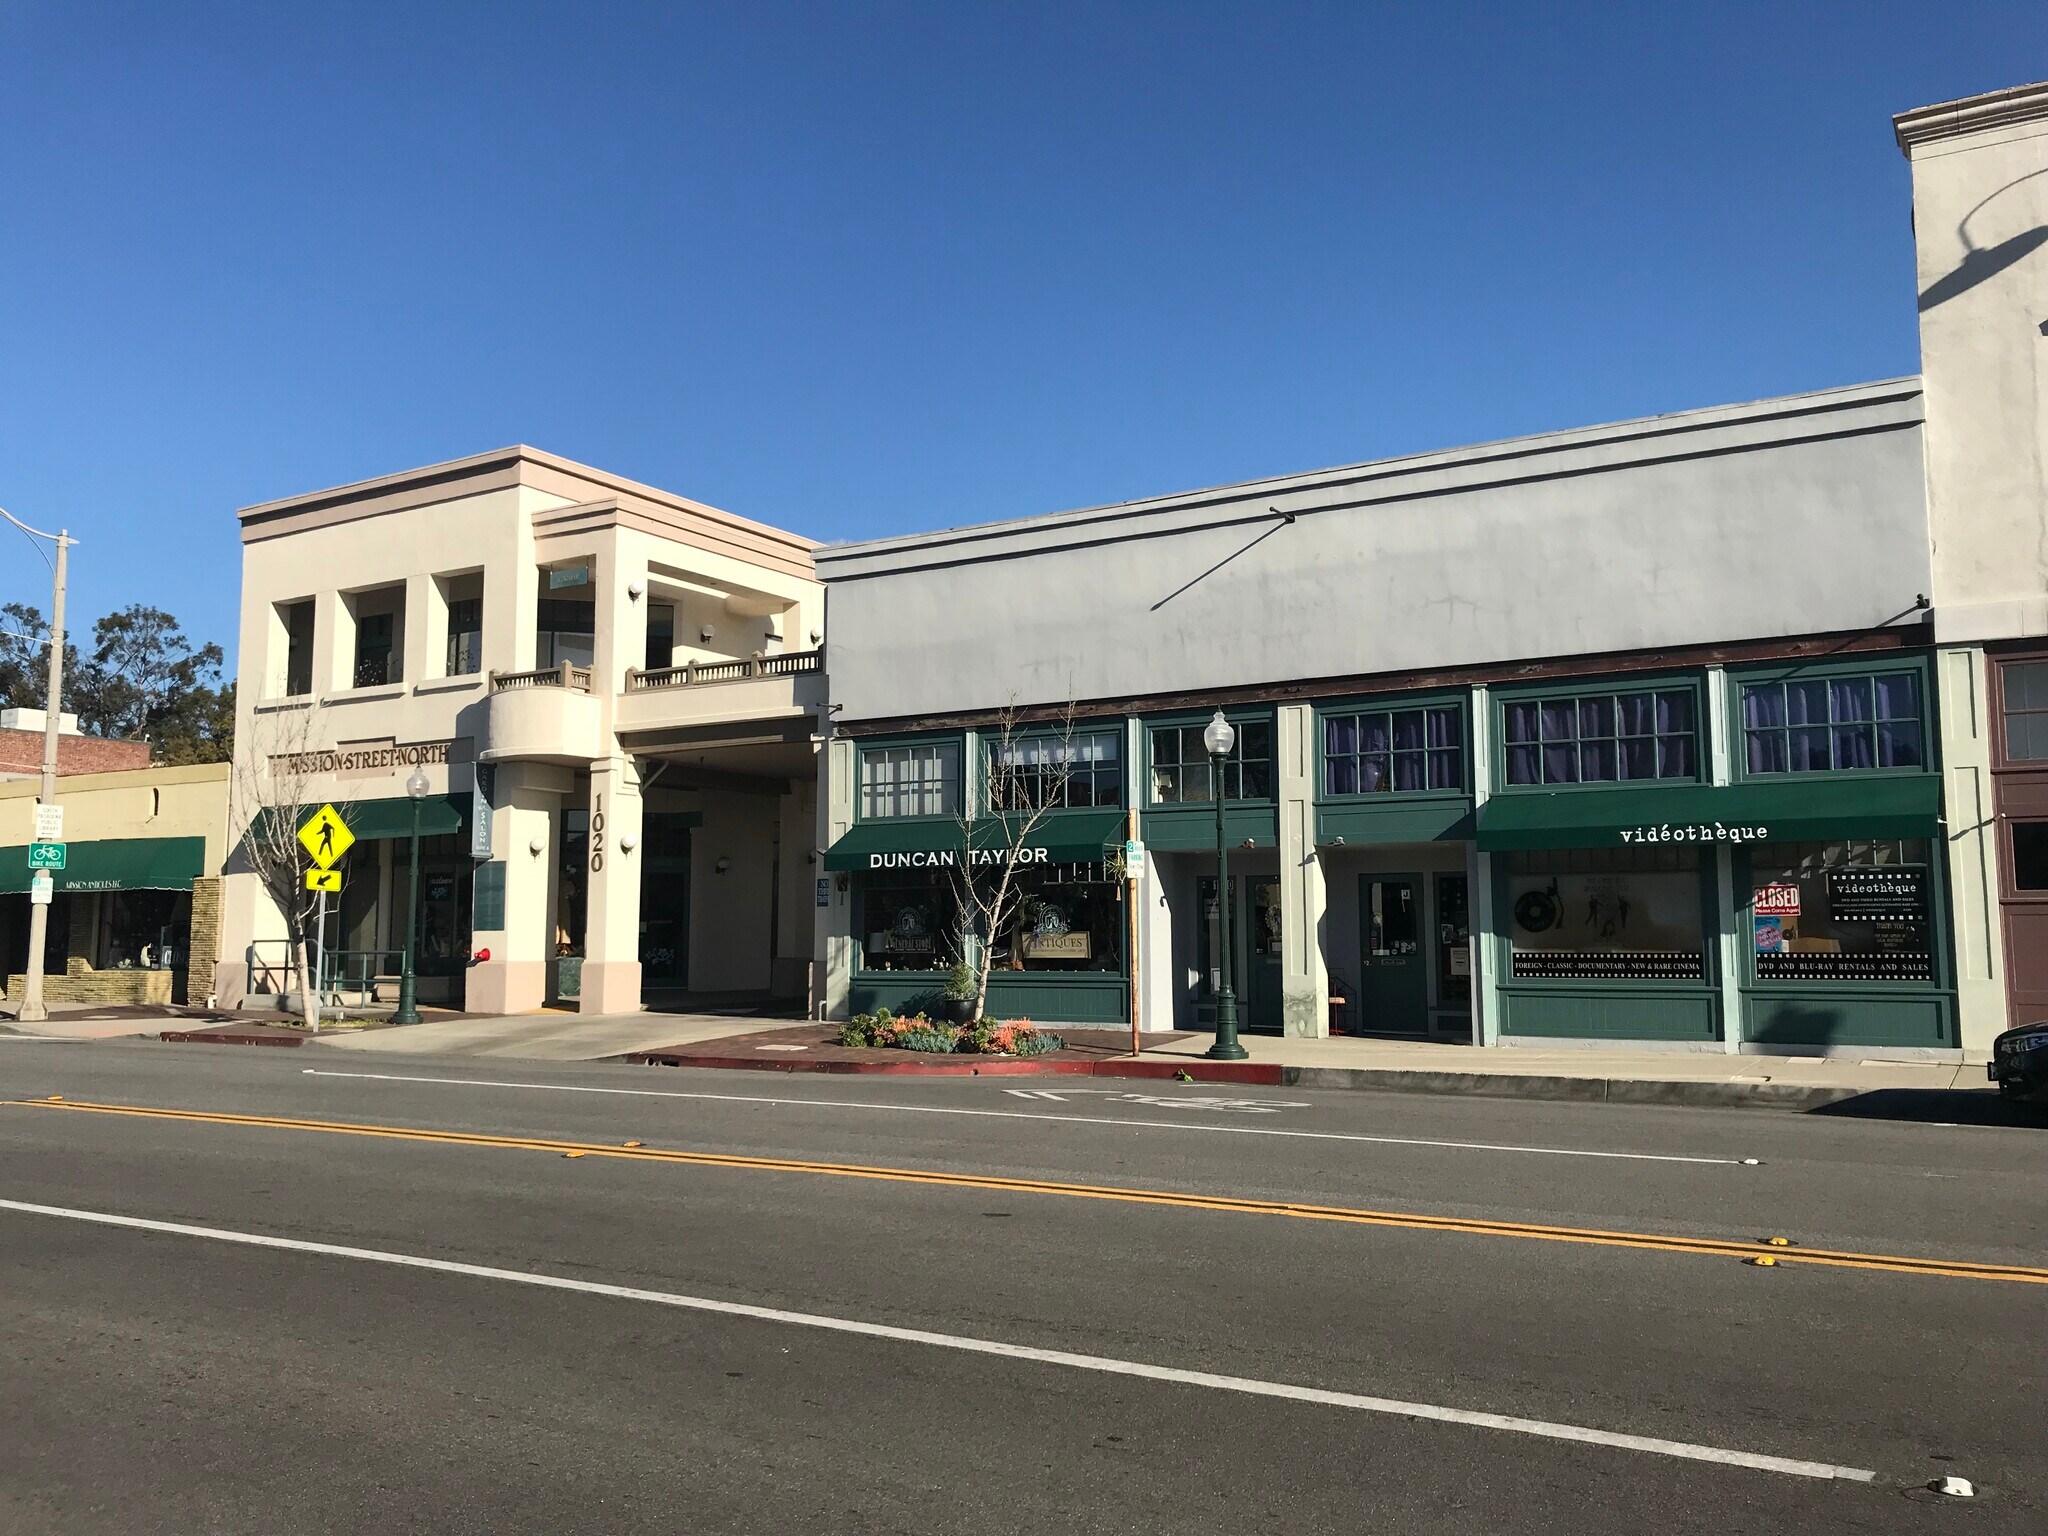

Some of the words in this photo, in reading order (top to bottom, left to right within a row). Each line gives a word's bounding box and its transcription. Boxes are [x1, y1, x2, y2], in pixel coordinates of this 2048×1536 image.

[590, 792, 605, 873] 1020
[1620, 821, 1768, 843] vidéothèque
[869, 851, 954, 869] DUNCAN
[968, 848, 1048, 865] TAYLOR
[1755, 887, 1799, 908] CLOSED
[1578, 962, 1626, 970] DOCUMENTARY
[1631, 962, 1645, 970] NEW
[1654, 962, 1672, 970] RARE
[1673, 962, 1700, 970] CINEMA
[1838, 963, 1876, 971] RENTALS
[1880, 963, 1898, 971] AND
[1902, 963, 1929, 971] SALES
